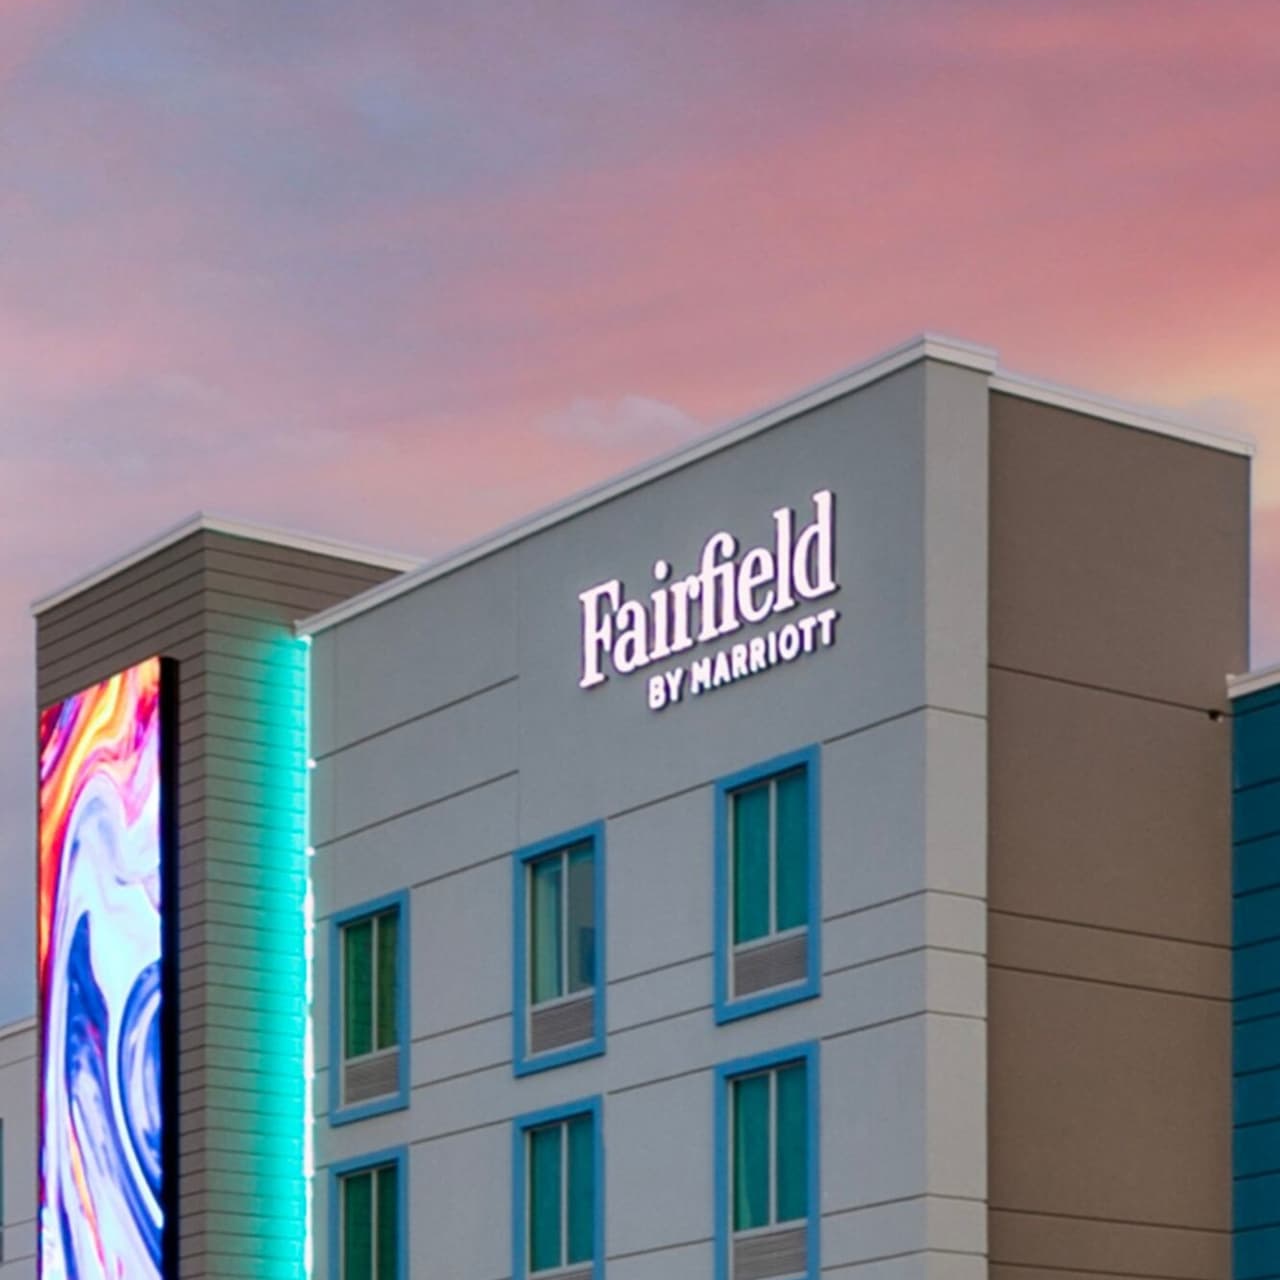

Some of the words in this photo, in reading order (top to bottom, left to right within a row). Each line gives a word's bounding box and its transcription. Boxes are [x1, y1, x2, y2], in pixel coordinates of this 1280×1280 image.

[578, 489, 836, 688] Fairfield
[649, 667, 683, 709] BY
[690, 608, 836, 694] MARRIOTT
